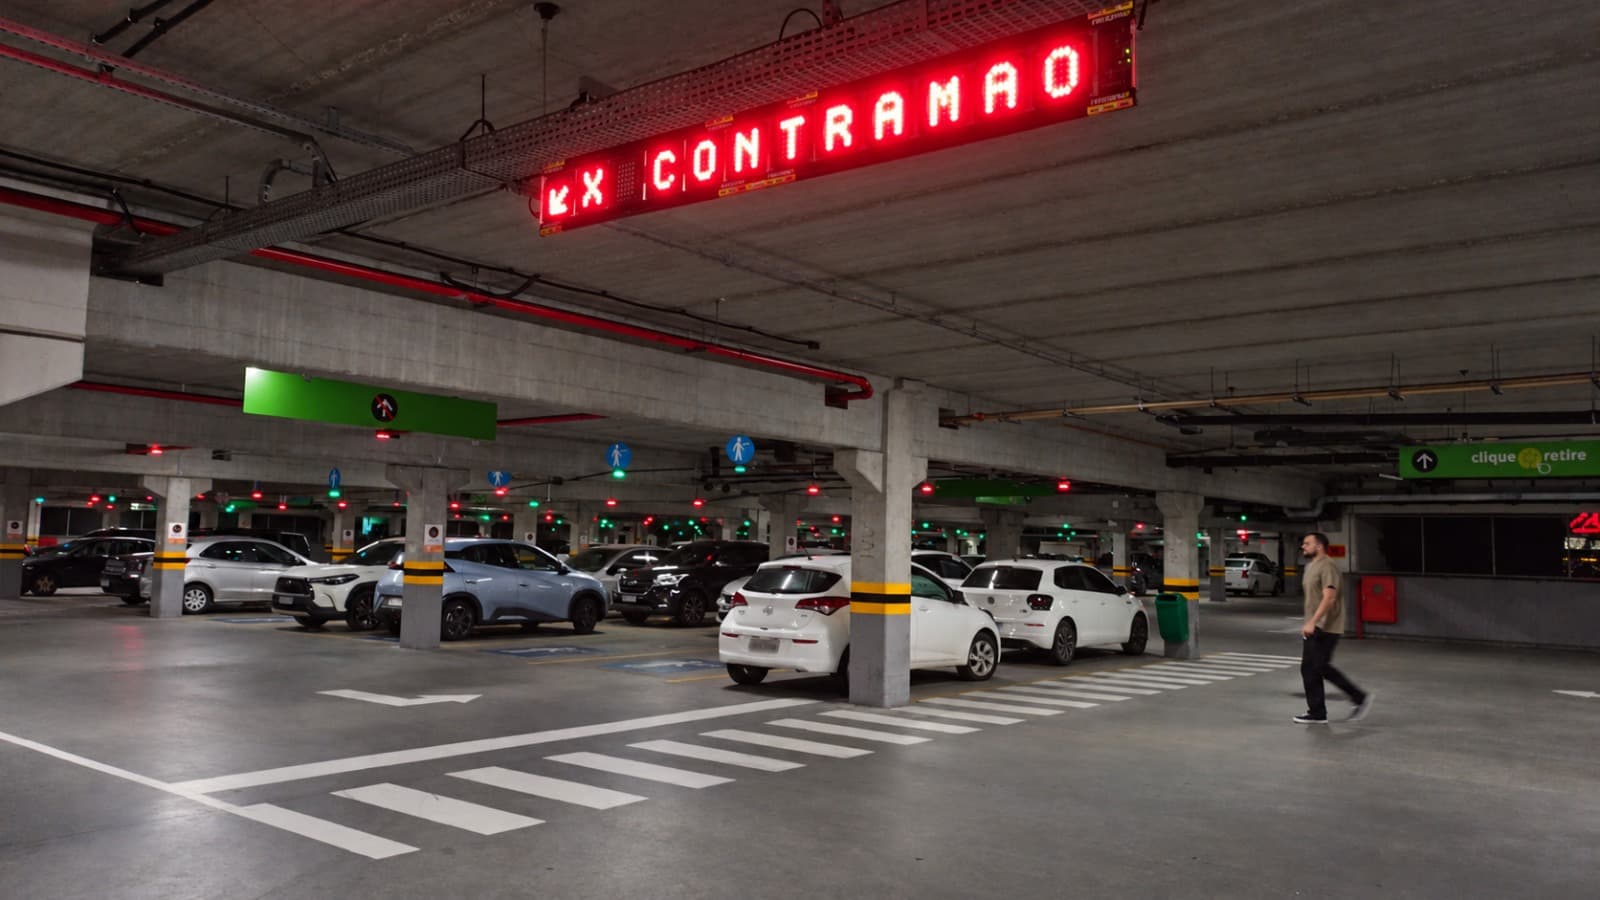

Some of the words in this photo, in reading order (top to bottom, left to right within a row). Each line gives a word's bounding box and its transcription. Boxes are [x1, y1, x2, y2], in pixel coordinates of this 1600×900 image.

[652, 45, 1080, 191] CONTRAMAO
[1471, 451, 1516, 465] clique
[1544, 449, 1587, 461] retire
